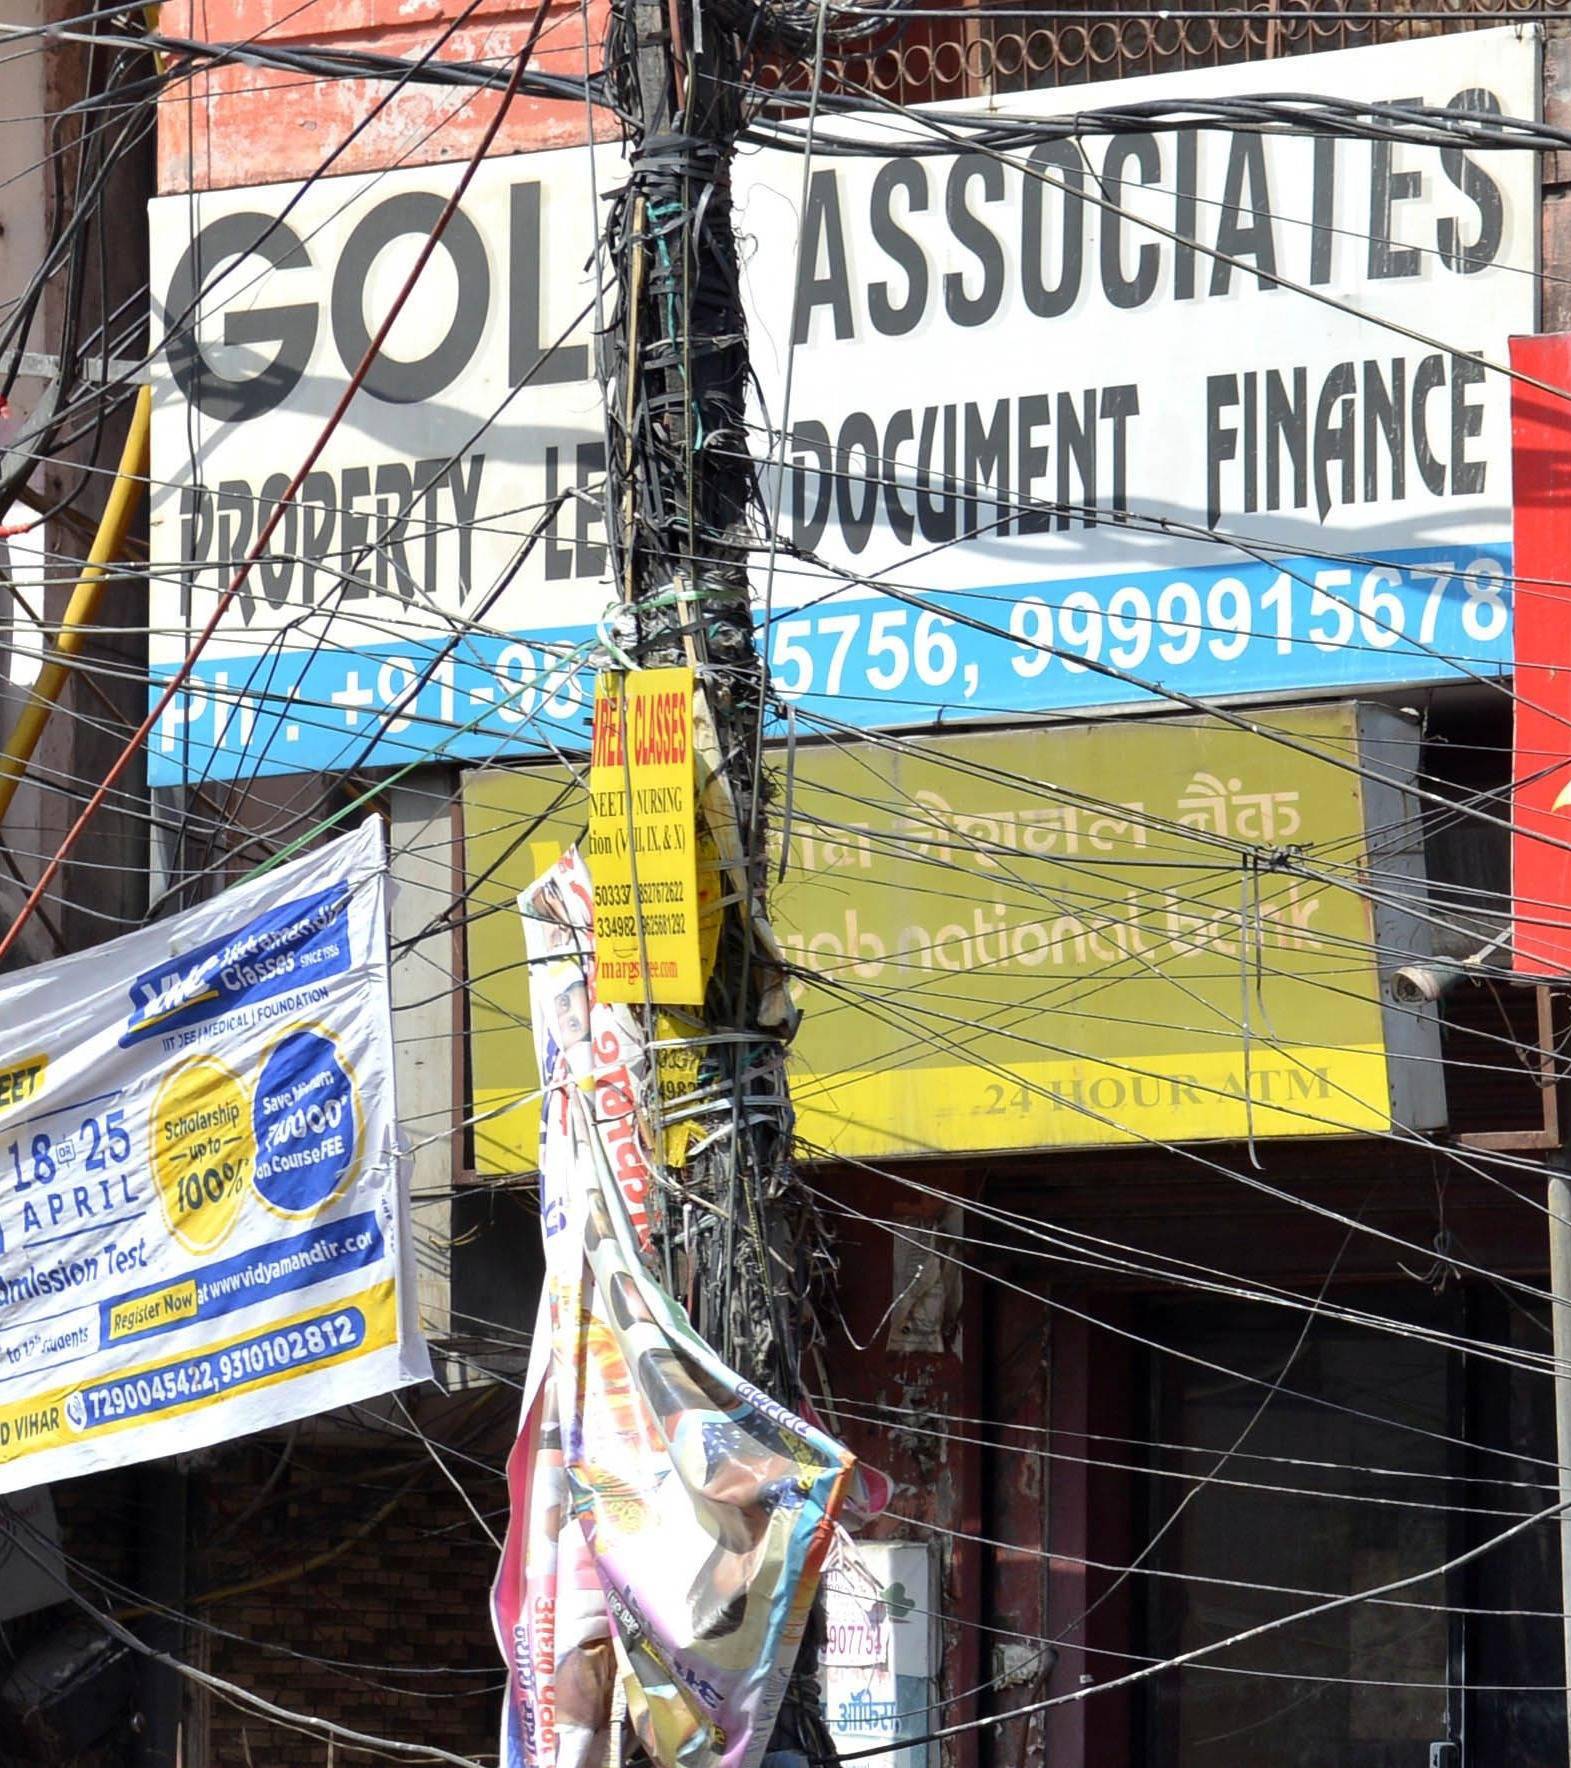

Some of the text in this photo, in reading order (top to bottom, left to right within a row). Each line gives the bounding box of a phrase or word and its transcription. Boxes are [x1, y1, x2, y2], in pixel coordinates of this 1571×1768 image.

[792, 87, 1505, 346] ASSOCIATES
[180, 452, 487, 630] PROPERTY
[790, 383, 1141, 557] DOCUMENT
[1206, 350, 1488, 530] FINANCE
[160, 670, 256, 754] Ph
[1009, 558, 1509, 682] 9999915678
[634, 691, 687, 767] CLASSES
[636, 786, 683, 816] NURSING
[899, 892, 1156, 975] national
[1166, 878, 1321, 957] bank
[219, 949, 297, 992] Classes
[203, 1013, 249, 1043] MEDICAL
[257, 985, 330, 1021] FOUNDATION
[262, 1094, 294, 1117] Save
[983, 1063, 1333, 1118] 24 HOUR ATM
[163, 1101, 240, 1142] Scholarship
[8, 1132, 57, 1194] 18
[78, 1108, 132, 1172] 25
[271, 1149, 320, 1173] Course
[320, 1134, 345, 1159] FEE
[22, 1174, 140, 1233] APRIL
[103, 1237, 148, 1276] Test
[113, 1301, 161, 1334] Register
[162, 1292, 193, 1316] Now
[14, 1407, 61, 1442] VIHAR
[218, 1315, 357, 1384] 9310102812
